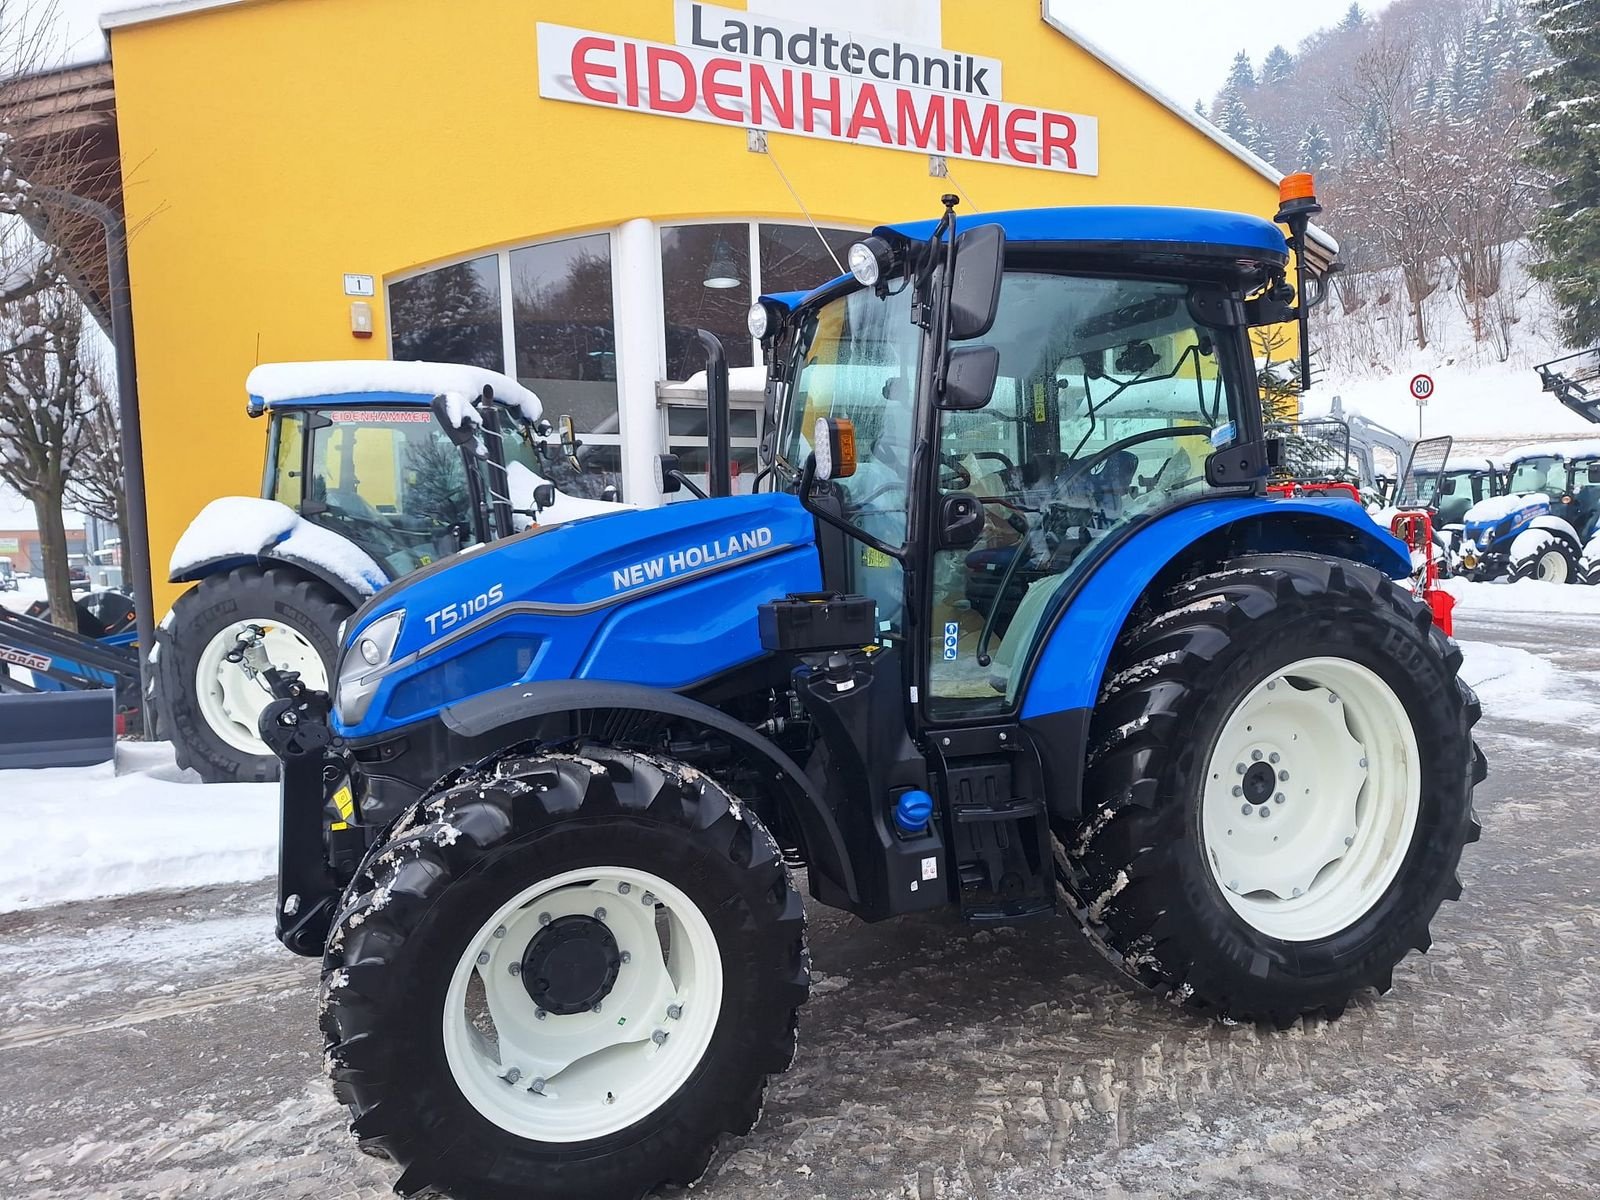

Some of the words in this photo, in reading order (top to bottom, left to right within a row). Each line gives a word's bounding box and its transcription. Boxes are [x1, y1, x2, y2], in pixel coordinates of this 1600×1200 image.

[691, 4, 990, 96] Landtechnik
[571, 36, 1078, 170] EIDENHAMMER
[1415, 380, 1429, 393] 80
[331, 411, 431, 422] EIDENHAMMER
[612, 553, 664, 590] NEW
[669, 526, 772, 573] HOLLAND
[424, 583, 504, 635] T5.110S
